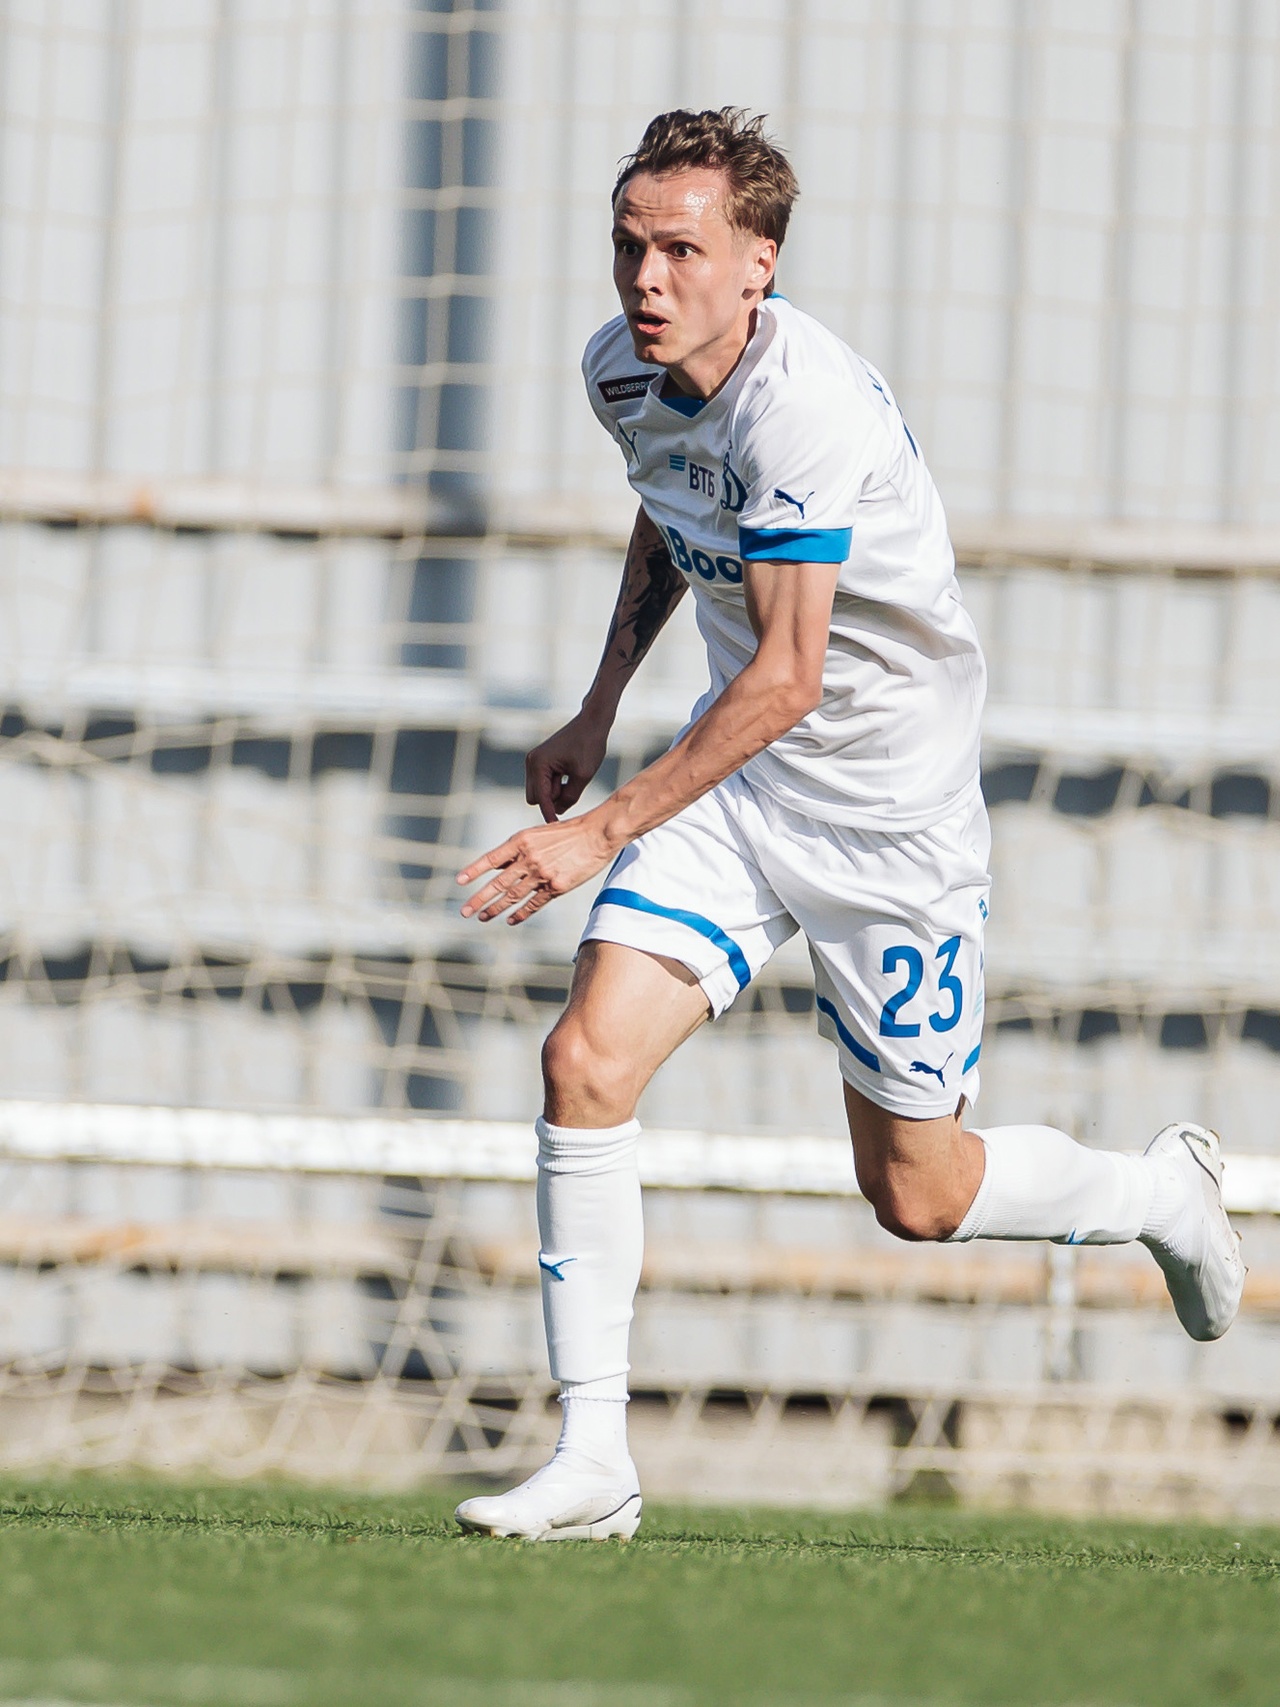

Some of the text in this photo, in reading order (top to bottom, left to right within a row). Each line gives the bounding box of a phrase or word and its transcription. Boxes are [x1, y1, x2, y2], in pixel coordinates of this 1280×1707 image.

[689, 462, 716, 499] ВТБ
[659, 521, 744, 584] Boo
[879, 935, 964, 1039] 23
